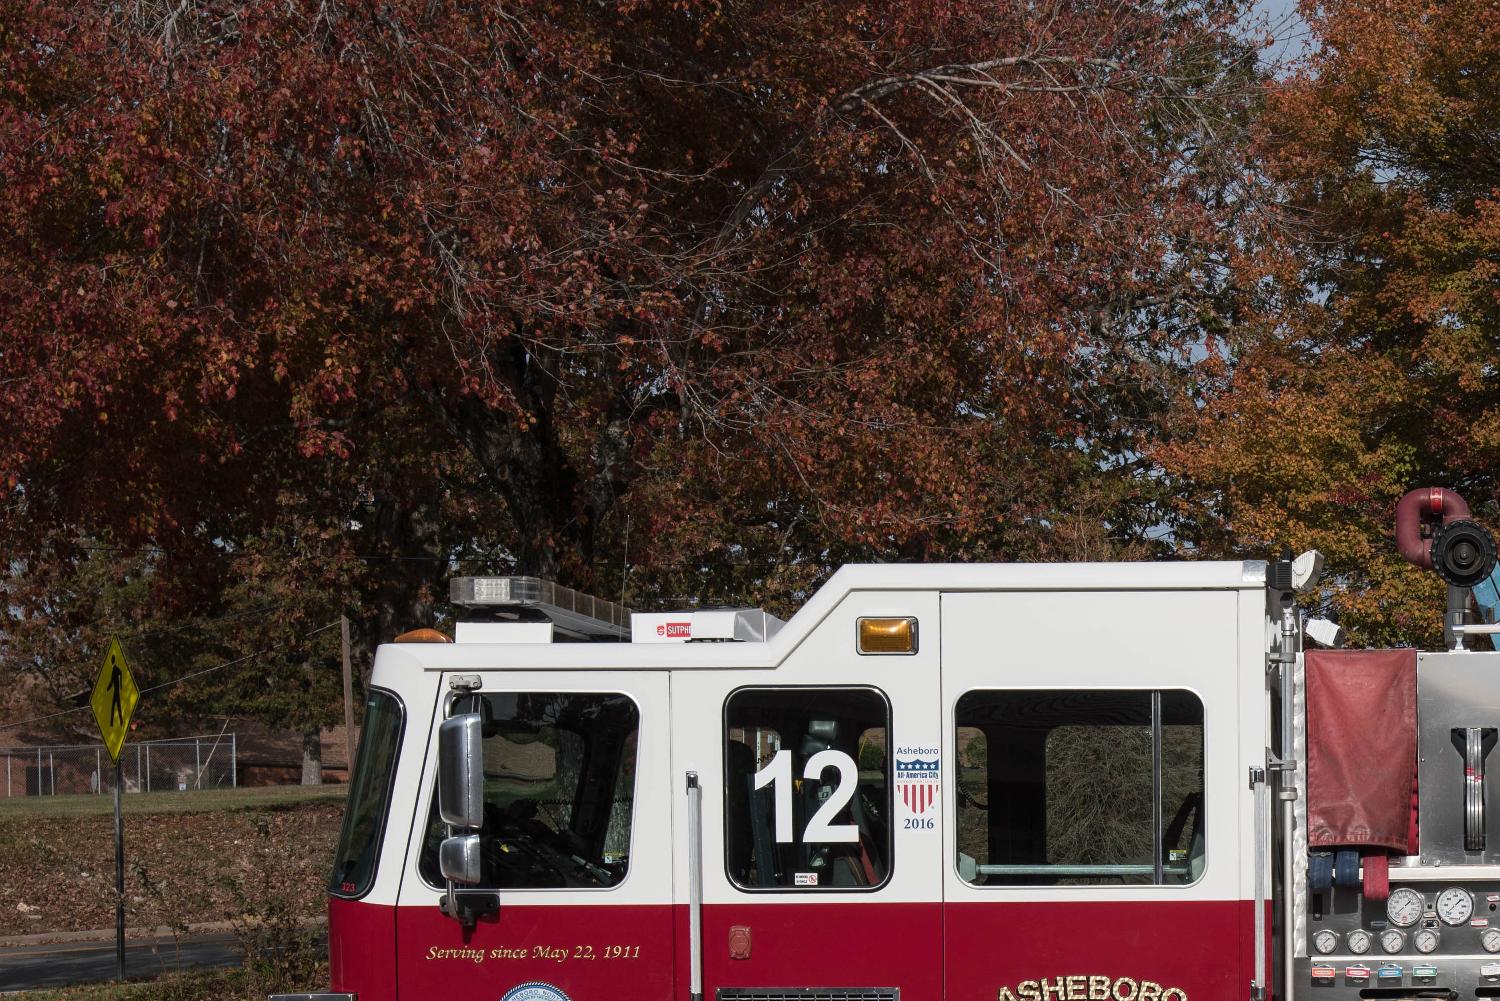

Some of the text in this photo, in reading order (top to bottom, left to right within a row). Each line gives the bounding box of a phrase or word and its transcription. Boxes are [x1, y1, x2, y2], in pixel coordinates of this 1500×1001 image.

[896, 747, 939, 755] Asheboro
[896, 771, 939, 780] All-America City
[754, 749, 860, 843] 12
[903, 818, 934, 829] 2016
[426, 945, 641, 964] Serving since May 22, 1911
